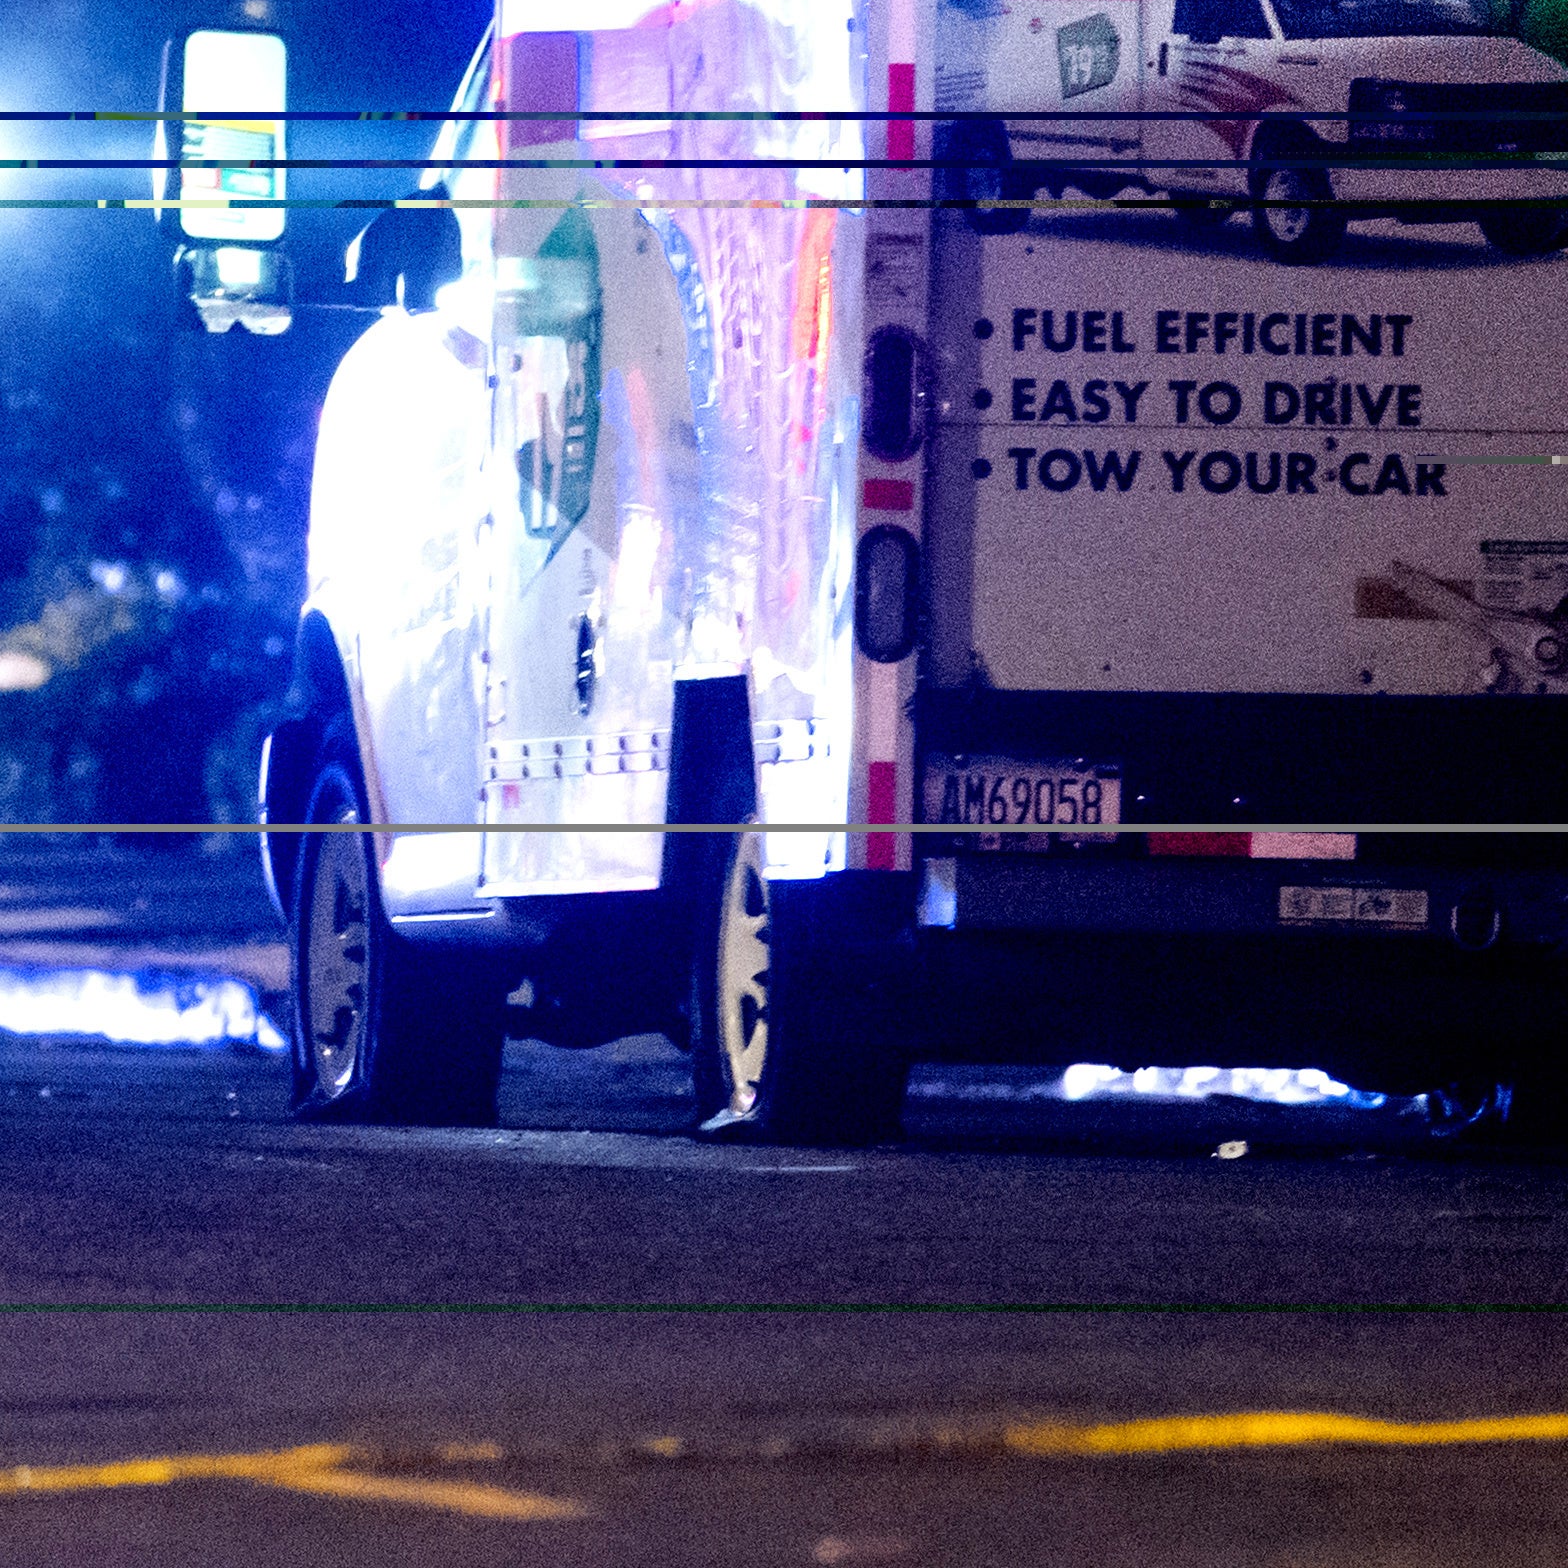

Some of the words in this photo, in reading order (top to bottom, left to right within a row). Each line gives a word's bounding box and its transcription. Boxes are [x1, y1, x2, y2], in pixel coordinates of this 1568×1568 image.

[1012, 308, 1136, 354] FUEL
[1155, 310, 1413, 357] EFFICIENT
[1012, 378, 1151, 423] EASY
[1169, 380, 1242, 425] TO
[1264, 382, 1422, 427] DRIVE
[1008, 447, 1141, 492] TOW
[1162, 450, 1318, 495] YOUR
[1339, 452, 1448, 497] CAR
